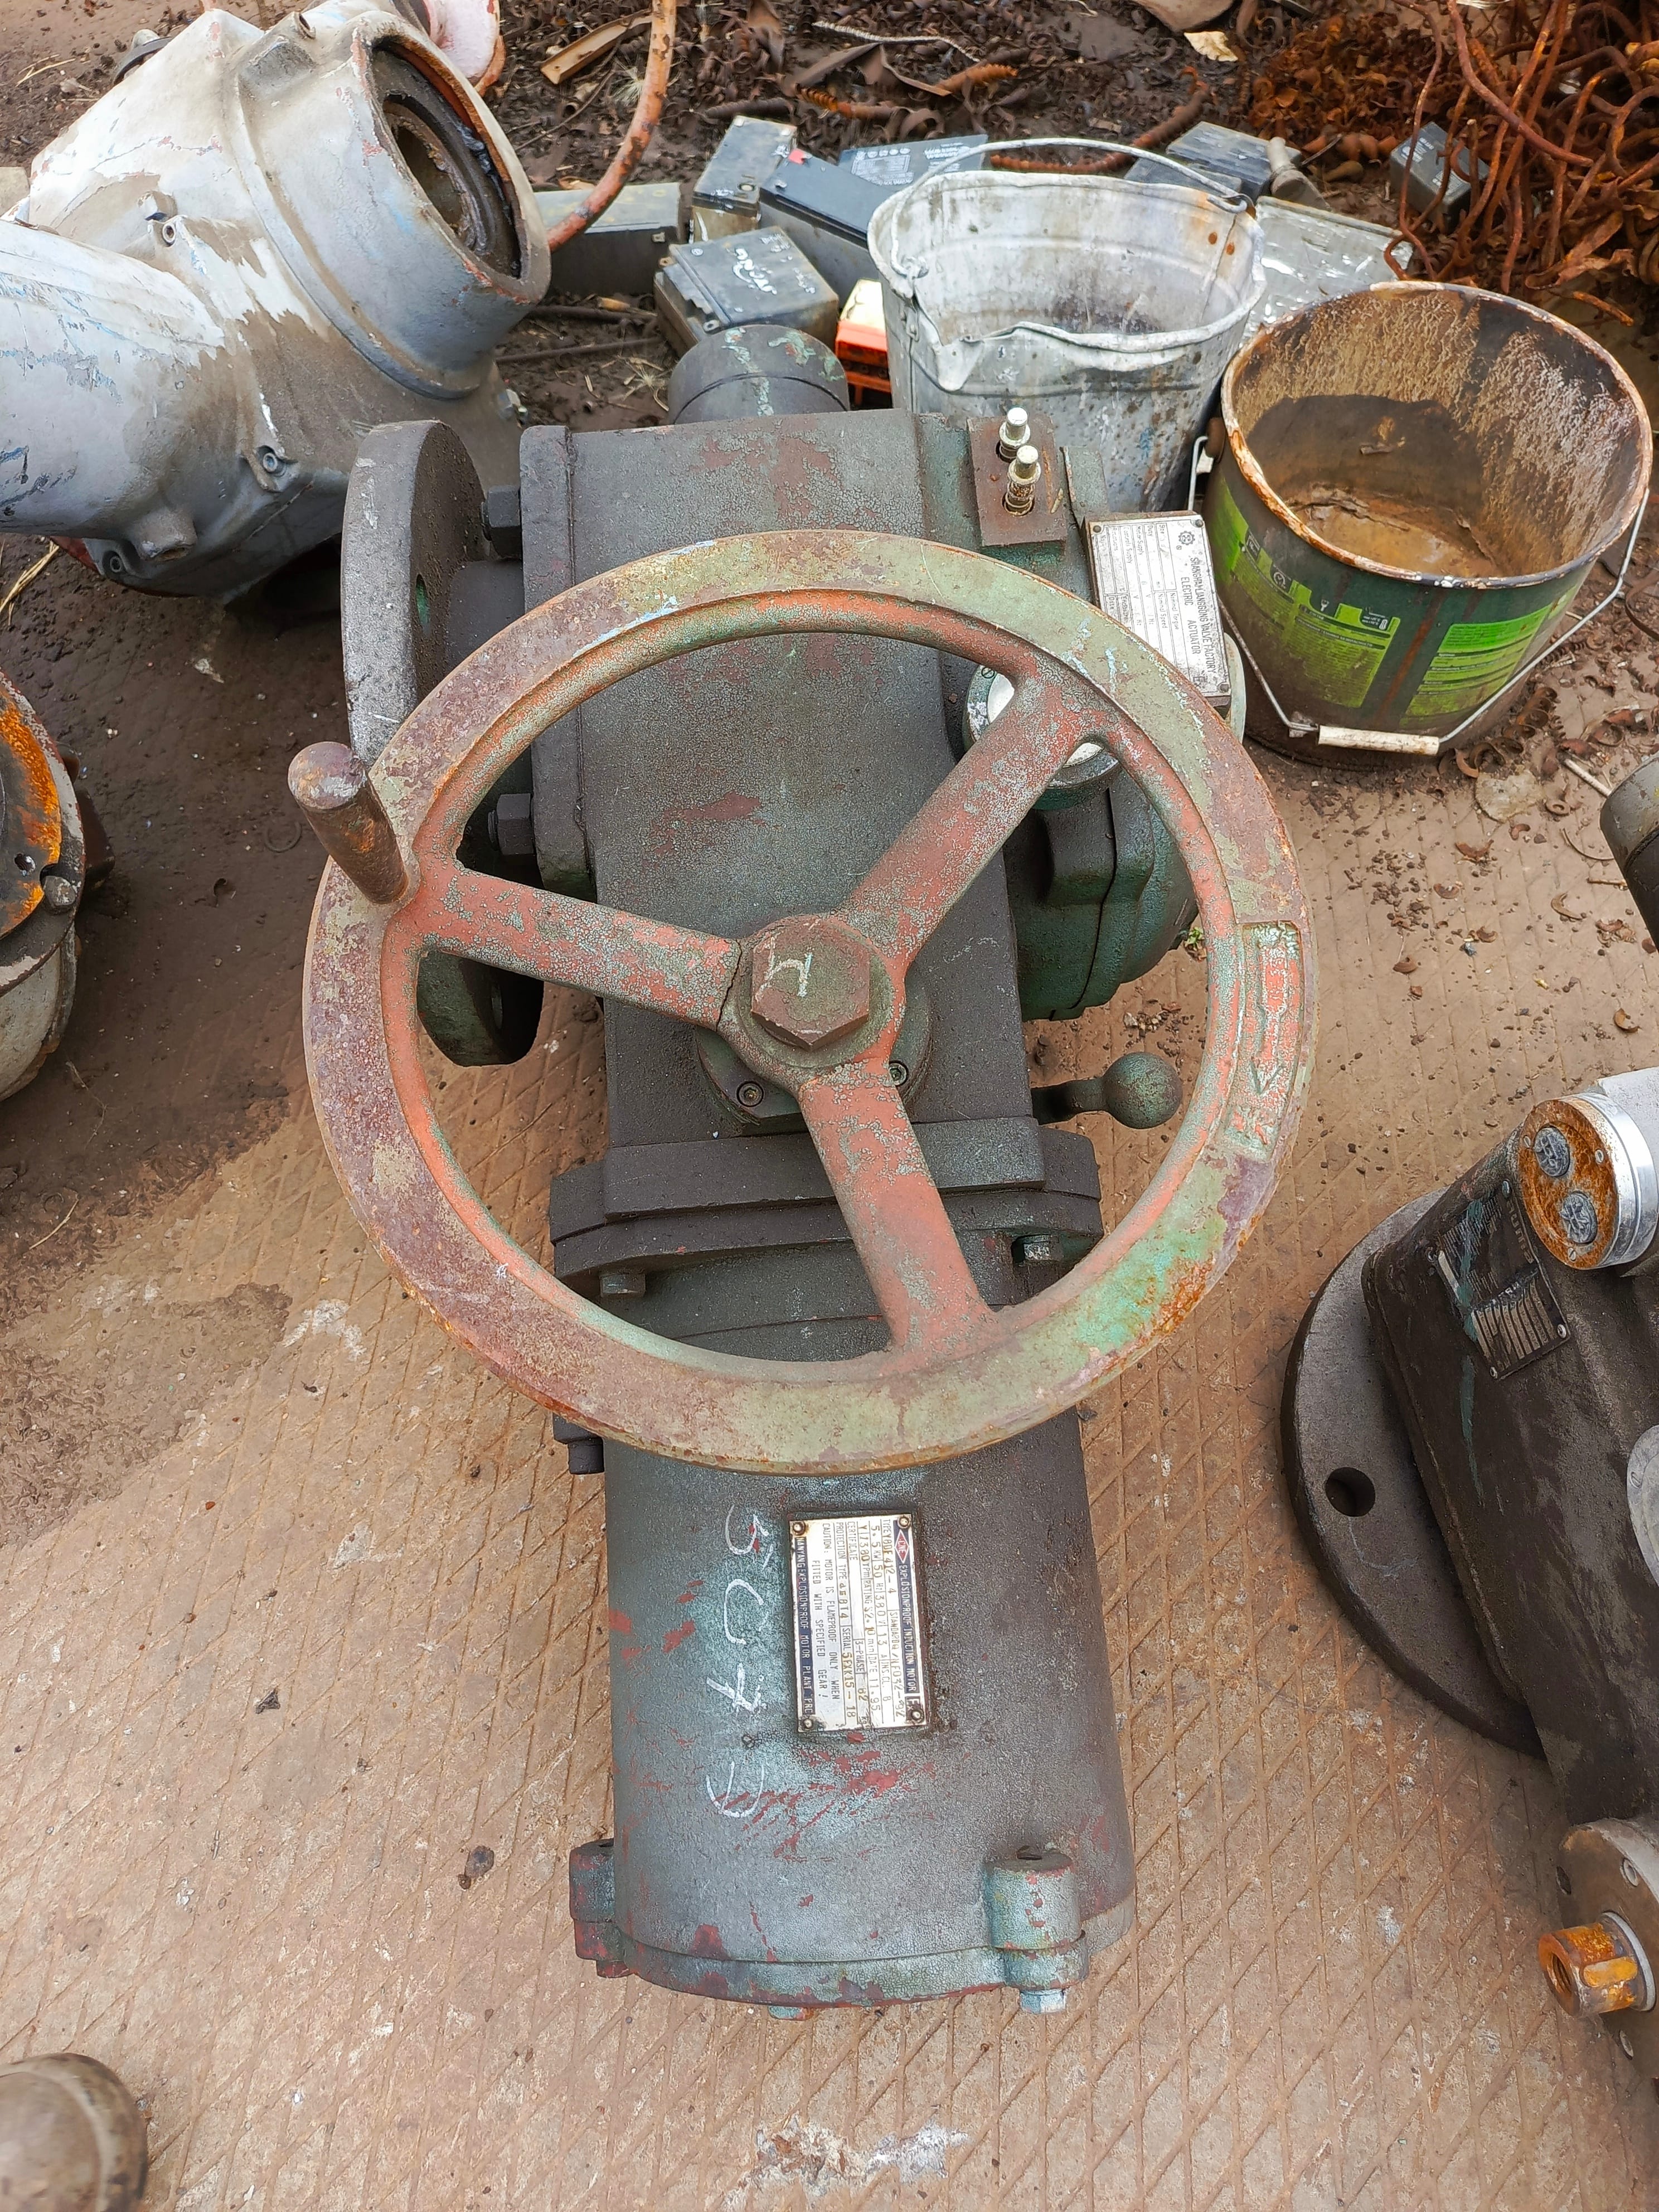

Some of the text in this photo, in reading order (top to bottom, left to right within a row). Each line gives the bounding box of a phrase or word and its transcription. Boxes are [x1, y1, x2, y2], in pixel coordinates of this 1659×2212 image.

[1181, 578, 1200, 654] ELECTRIC ACTUATOR
[1201, 623, 1212, 642] VALVE
[1204, 644, 1216, 673] FACTORY
[836, 1522, 847, 1559] PROTECTION
[847, 1522, 857, 1560] CERTIFICATE
[860, 1536, 870, 1561] 1380
[796, 1538, 806, 1568] NANYANG
[812, 1561, 821, 1584] FITTED
[825, 1560, 833, 1580] MOTOR
[874, 1565, 882, 1578] 50
[798, 1570, 808, 1629] EXPLOSIONPROOF
[814, 1594, 822, 1610] WITH
[863, 1580, 872, 1604] RATING
[899, 1565, 911, 1624] EXPLOSIONPROOF
[875, 1595, 886, 1616] 380
[826, 1601, 837, 1642] FLAMEPROOF
[801, 1635, 810, 1658] MOTOR
[816, 1619, 825, 1656] SPECIFIED
[843, 1628, 852, 1651] SERIAL
[878, 1633, 887, 1646] 13
[903, 1628, 914, 1664] INDUCTION
[829, 1652, 838, 1670] ONLY
[856, 1641, 865, 1672] 3-PHASE
[869, 1657, 877, 1672] DATE
[803, 1666, 812, 1689] PLANT
[907, 1668, 916, 1691] MOTOR
[831, 1680, 840, 1699] WHEN
